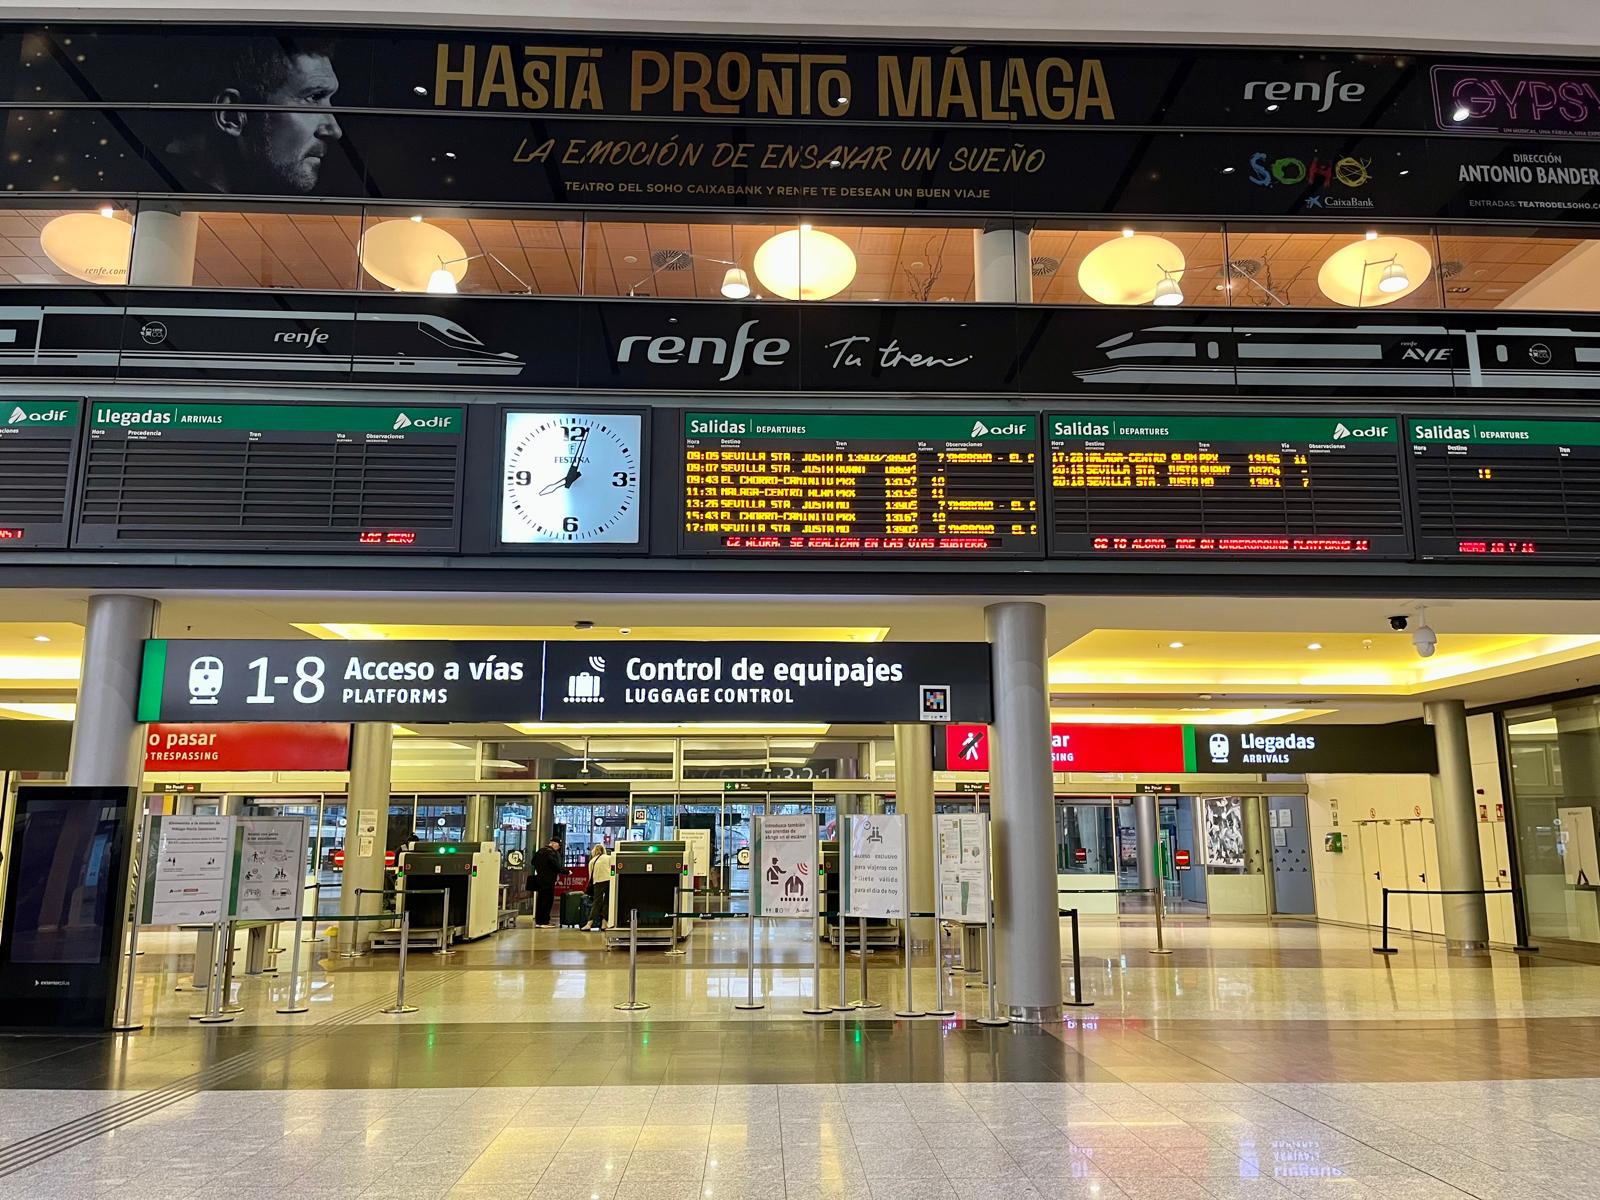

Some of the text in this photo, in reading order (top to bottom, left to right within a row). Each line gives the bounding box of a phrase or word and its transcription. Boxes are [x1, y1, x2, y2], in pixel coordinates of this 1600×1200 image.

[434, 43, 1116, 121] HASTA PRONTO MÁLAGA
[1244, 70, 1366, 112] renfe
[513, 135, 1046, 173] LA EMOCIÓN DE ENSAYAR UN SUEÑO
[1513, 152, 1562, 164] DIRECCIÓN
[1250, 152, 1372, 188] SOHO
[1459, 164, 1533, 183] ANTONIO
[565, 181, 991, 200] TEATRO DEL SOHO CAIXABANK Y RENFE TE DESEAN UN BUEN VIAJE
[1324, 196, 1374, 208] CaixaBank
[84, 266, 127, 276] renfe.com
[274, 327, 329, 349] renfe
[616, 319, 973, 382] renfe Tu tren
[1401, 348, 1454, 362] AVE
[29, 410, 68, 421] adif
[97, 409, 171, 426] Llegadas
[181, 415, 223, 424] ARRIVALS
[413, 416, 453, 428] adif
[561, 426, 587, 442] 12
[690, 419, 746, 434] Salidas
[756, 425, 806, 434] DEPARTURES
[990, 424, 1027, 435] adif
[1054, 421, 1109, 436] Salidas
[1119, 426, 1169, 436] DEPARTURES
[1352, 426, 1389, 437] adif
[1415, 425, 1470, 440] Salidas
[1480, 431, 1529, 440] DEPARTURES
[686, 451, 719, 461] 09:05
[721, 452, 766, 461] SEVILLA
[686, 463, 719, 472] 09:07
[721, 464, 766, 473] SEVILLA
[515, 470, 532, 486] 9
[612, 471, 628, 487] 3
[686, 475, 719, 485] 09:43
[721, 475, 735, 485] EL
[686, 487, 718, 496] 11:31
[721, 499, 766, 509] SEVILLA
[562, 516, 579, 532] 6
[344, 654, 524, 681] Acceso a vías
[625, 656, 904, 688] Control de equipajes
[246, 655, 327, 705] 1-8
[342, 688, 448, 704] PLATFORMS
[625, 688, 794, 704] LUGGAGE CONTROL
[166, 734, 217, 751] pasar
[1241, 733, 1315, 752] Llegadas
[151, 751, 219, 761] TRESPASSING
[1242, 753, 1290, 764] ARRIVALS
